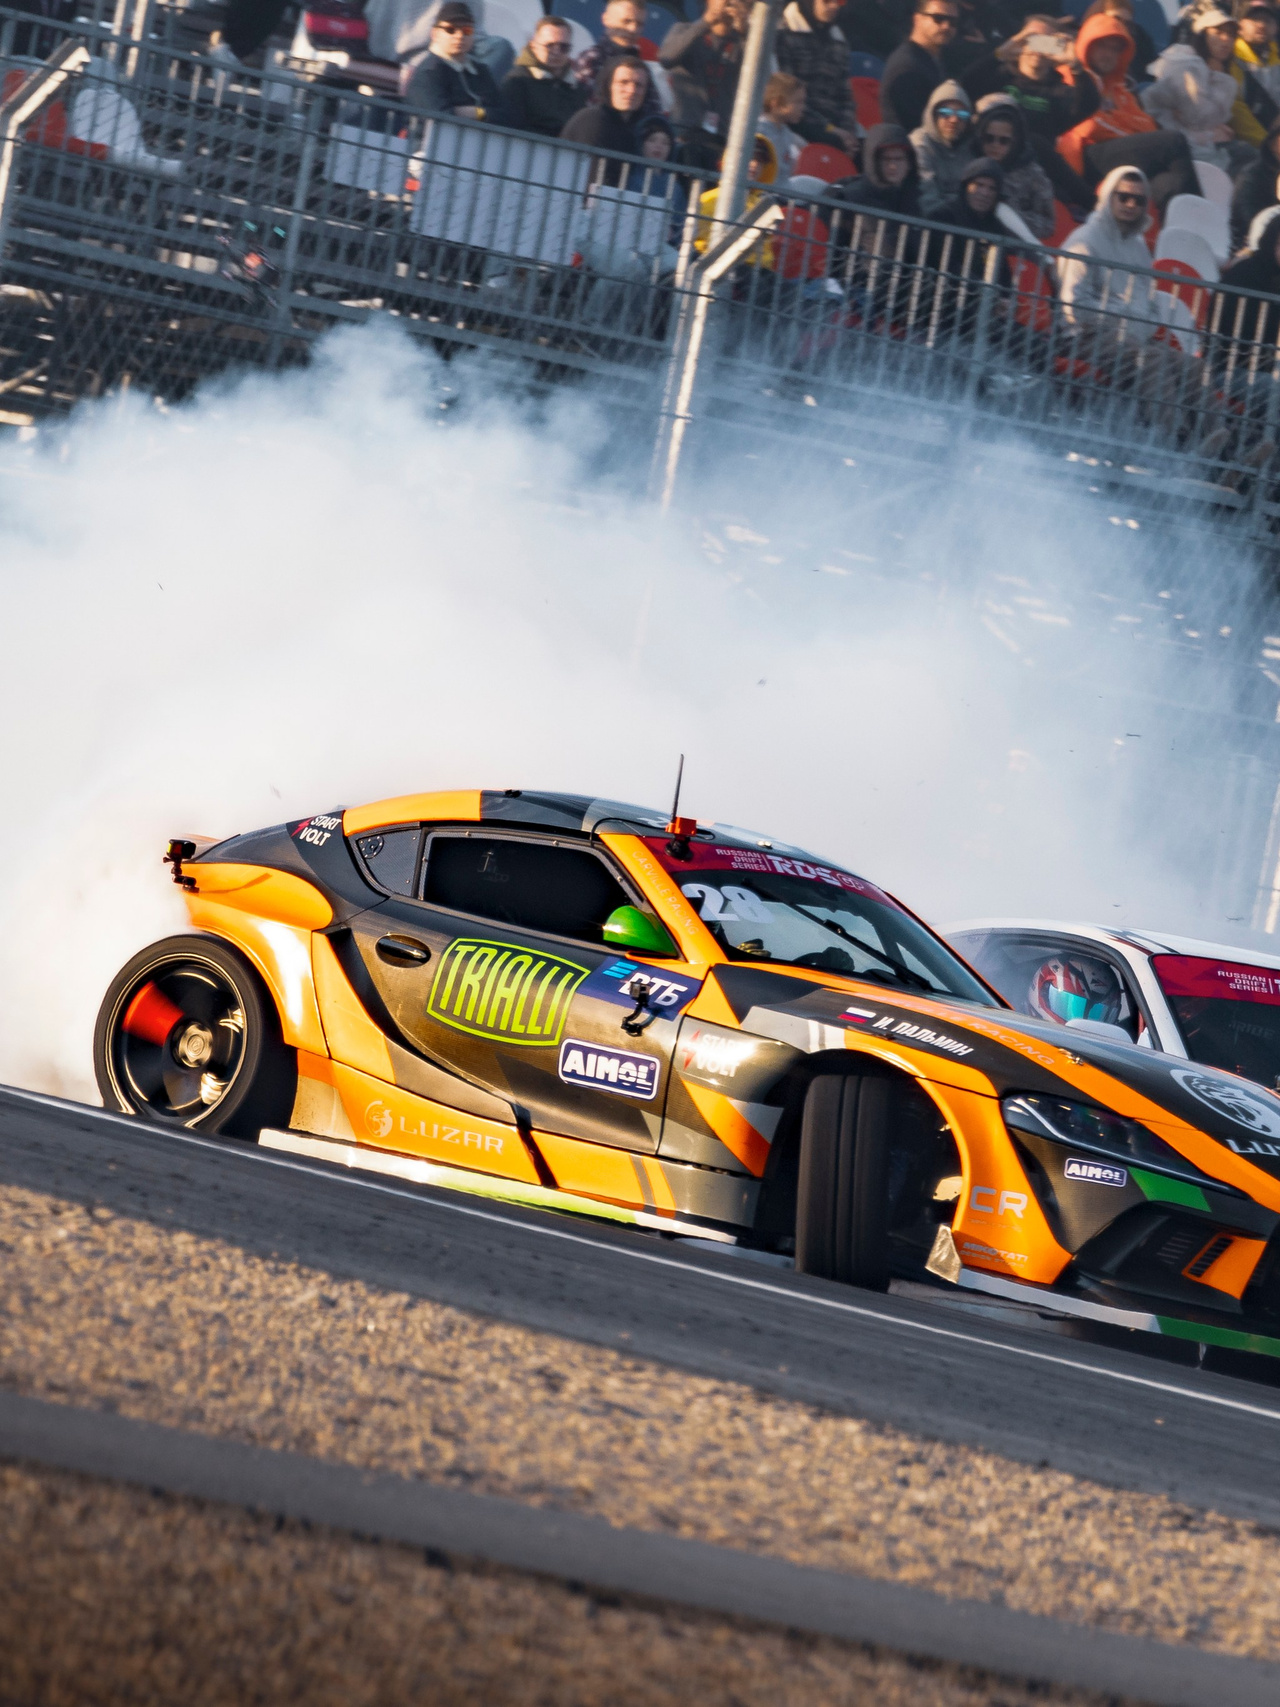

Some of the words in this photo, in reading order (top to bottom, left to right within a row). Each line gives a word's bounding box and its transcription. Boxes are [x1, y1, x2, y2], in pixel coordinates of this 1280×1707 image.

[310, 815, 342, 830] START
[299, 827, 331, 846] VOLT
[715, 848, 761, 859] RUSSIAN
[734, 856, 763, 865] DRIFT
[731, 861, 767, 871] SERIES
[766, 854, 841, 887] RDS
[631, 850, 670, 896] CARVILLE
[668, 894, 699, 935] RACING
[681, 883, 775, 924] 28
[1217, 970, 1266, 983] RUSSIAN
[1234, 979, 1267, 988] DRIFT
[439, 944, 574, 1035] TRIALLI
[1229, 983, 1268, 993] SERIES
[872, 1016, 890, 1030] И.
[891, 1022, 974, 1056] ПАЛЬМИН
[968, 1022, 1055, 1065] RACING
[562, 1050, 653, 1091] AIMOL
[696, 1056, 741, 1077] VOLT
[400, 1116, 504, 1154] LUZAR
[1067, 1163, 1123, 1183] AIMOL
[970, 1185, 1028, 1218] CR
